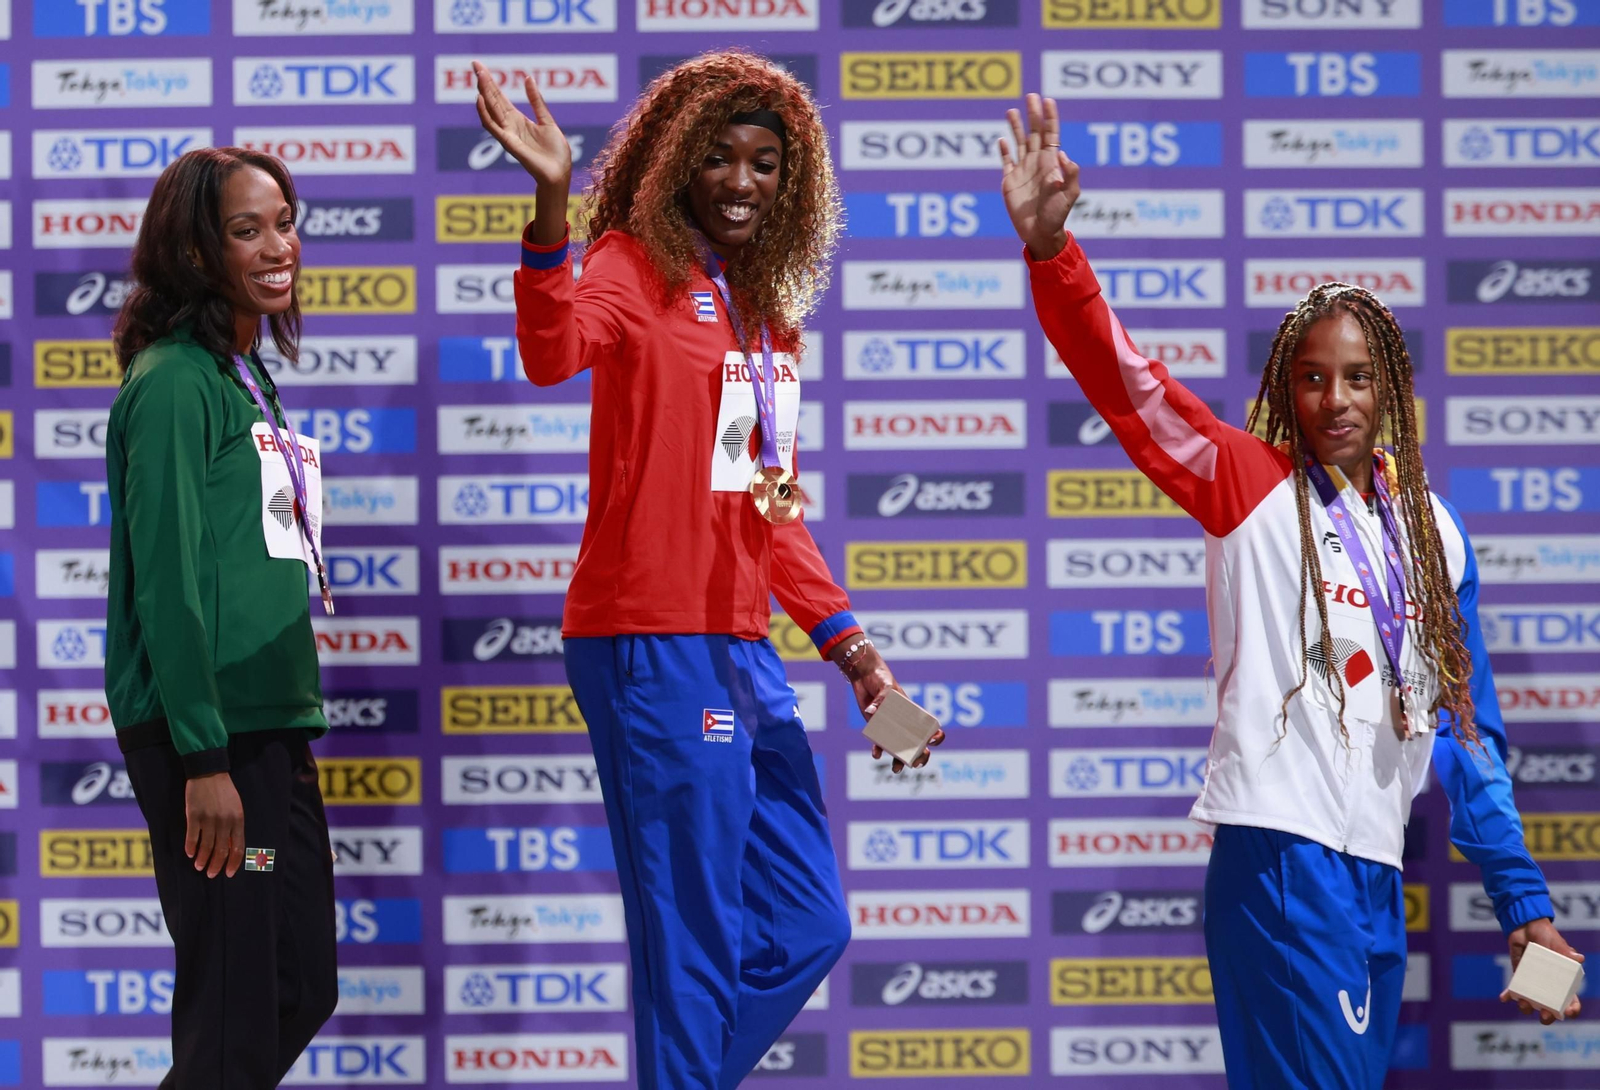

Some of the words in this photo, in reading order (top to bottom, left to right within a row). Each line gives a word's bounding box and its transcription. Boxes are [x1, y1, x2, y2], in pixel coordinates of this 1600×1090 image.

[77, 0, 168, 35] TBS
[647, 0, 810, 18] HONDA
[1050, 0, 1213, 22] SEIKO
[1261, 0, 1395, 18] SONY
[55, 69, 122, 103] Tokyo
[122, 67, 187, 96] Tokyo
[284, 63, 399, 97] TDK
[849, 59, 1013, 92] SEIKO
[1061, 62, 1202, 87] SONY
[1287, 54, 1378, 95] TBS
[1468, 61, 1533, 91] Tokyo
[1534, 59, 1597, 84] Tokyo
[84, 136, 195, 170] TDK
[861, 132, 1002, 158] SONY
[1087, 124, 1180, 167] TBS
[1269, 131, 1333, 161] Tokyo
[1334, 131, 1399, 155] Tokyo
[1494, 128, 1600, 158] TDK
[41, 212, 138, 236] HON
[304, 206, 382, 236] asics
[886, 194, 979, 237] TBS
[1136, 200, 1201, 226] Tokyo
[1295, 198, 1406, 228] TDK
[1453, 203, 1600, 224] HONDA
[297, 273, 407, 306] EIKO
[866, 271, 933, 303] Tokyo
[934, 268, 1000, 297] Tokyo
[1098, 267, 1207, 300] TDK
[1514, 269, 1589, 297] asics
[897, 339, 1008, 371] TDK
[463, 414, 528, 447] Tokyo
[853, 414, 1016, 437] HONDA
[1465, 411, 1600, 433] SONY
[328, 487, 394, 515] Tokyo
[916, 481, 994, 511] asics
[1490, 470, 1582, 511] TBS
[324, 557, 401, 587] DK
[447, 560, 577, 582] HOND
[855, 548, 1019, 582] SEIKO
[1065, 549, 1206, 577] SONY
[315, 630, 412, 653] NDA
[865, 621, 1008, 650] SONY
[1092, 611, 1185, 653] TBS
[450, 694, 580, 727] SEIK
[1072, 690, 1139, 721] Tokyo
[1140, 689, 1205, 716] Tokyo
[703, 735, 733, 743] ATLETISMO
[321, 766, 412, 799] IKO
[460, 766, 600, 794] SONY
[939, 759, 1005, 786] Tokyo
[1101, 757, 1206, 789] TDK
[1517, 754, 1595, 782] asics
[333, 838, 401, 866] NY
[486, 829, 579, 871] TBS
[900, 829, 1012, 861] TDK
[1058, 833, 1213, 855] HONDA
[59, 910, 162, 938] SON
[466, 905, 533, 938] Tokyo
[534, 905, 602, 933] Tokyo
[857, 905, 1020, 926] HONDA
[1120, 898, 1198, 927] asics
[84, 969, 174, 1014] TBS
[496, 973, 608, 1004] TDK
[920, 971, 997, 998] asics
[1057, 966, 1212, 999] SEIKO
[303, 1045, 410, 1079] TDK
[453, 1048, 618, 1070] HONDA
[858, 1036, 1022, 1069] SEIKO
[1069, 1036, 1210, 1065] SONY
[1475, 1032, 1541, 1063] Tokyo
[68, 1048, 133, 1081] Tokyo
